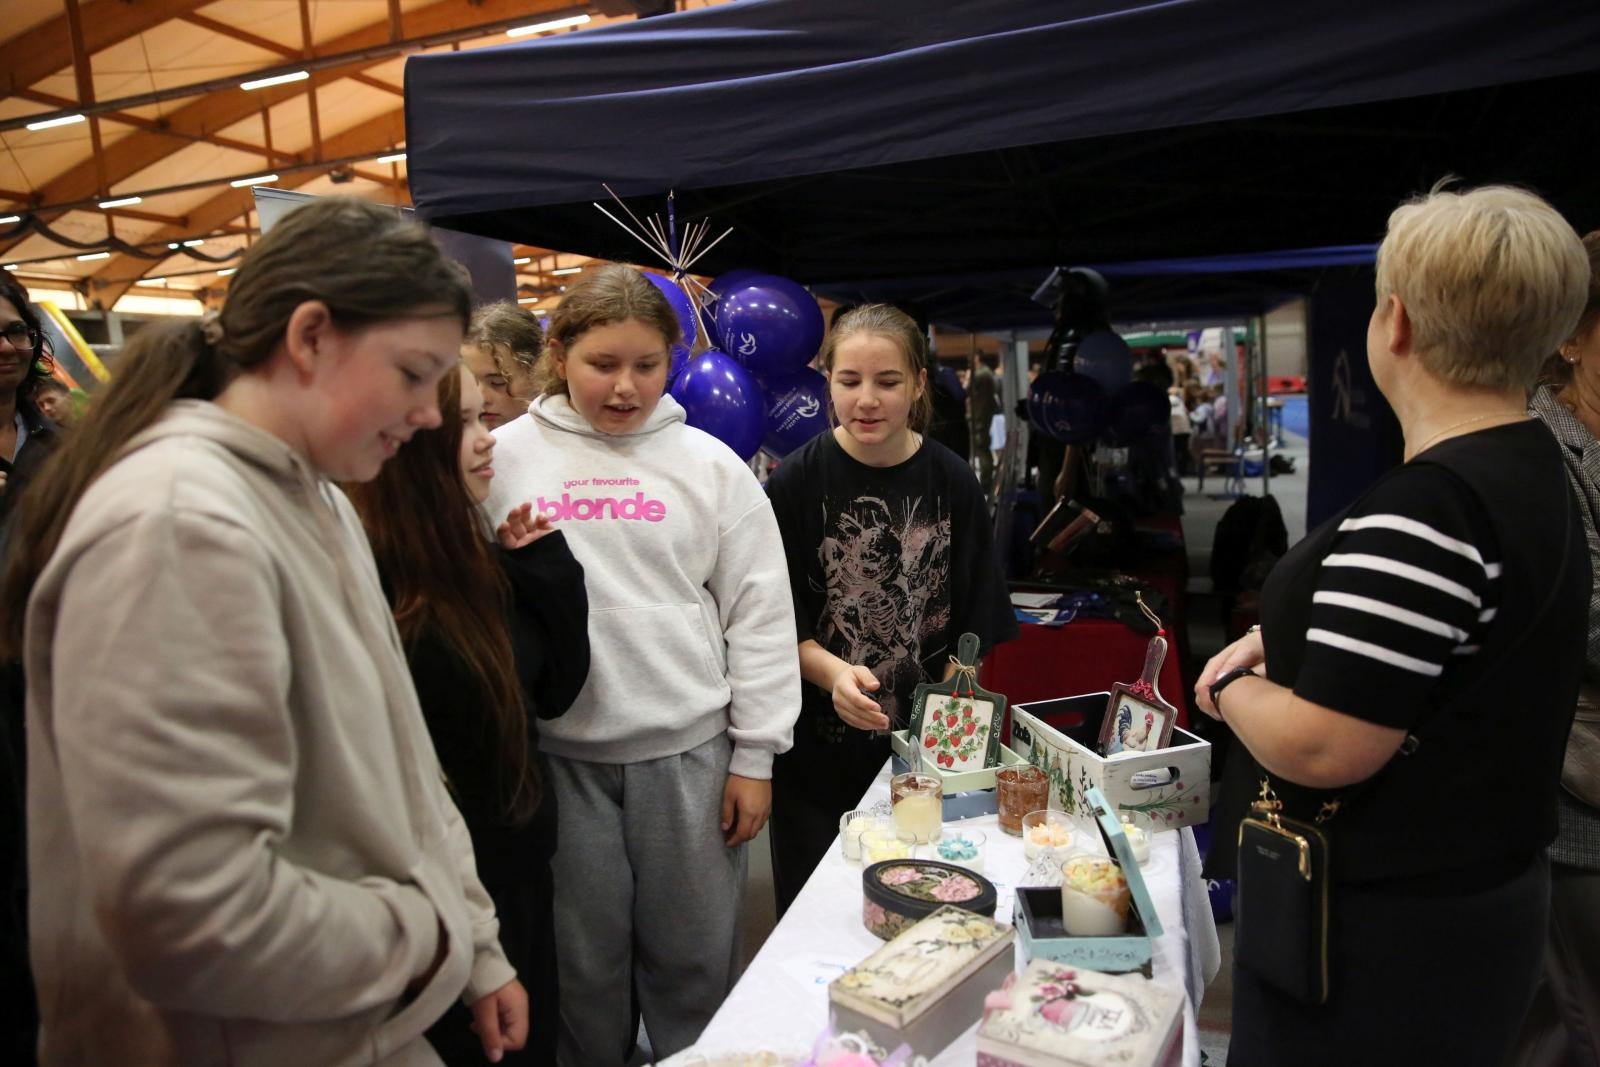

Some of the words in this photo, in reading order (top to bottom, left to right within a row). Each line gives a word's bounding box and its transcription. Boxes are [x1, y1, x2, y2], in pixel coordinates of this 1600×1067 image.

[564, 479, 589, 489] your
[592, 477, 640, 486] favourite
[537, 492, 666, 522] blonde
